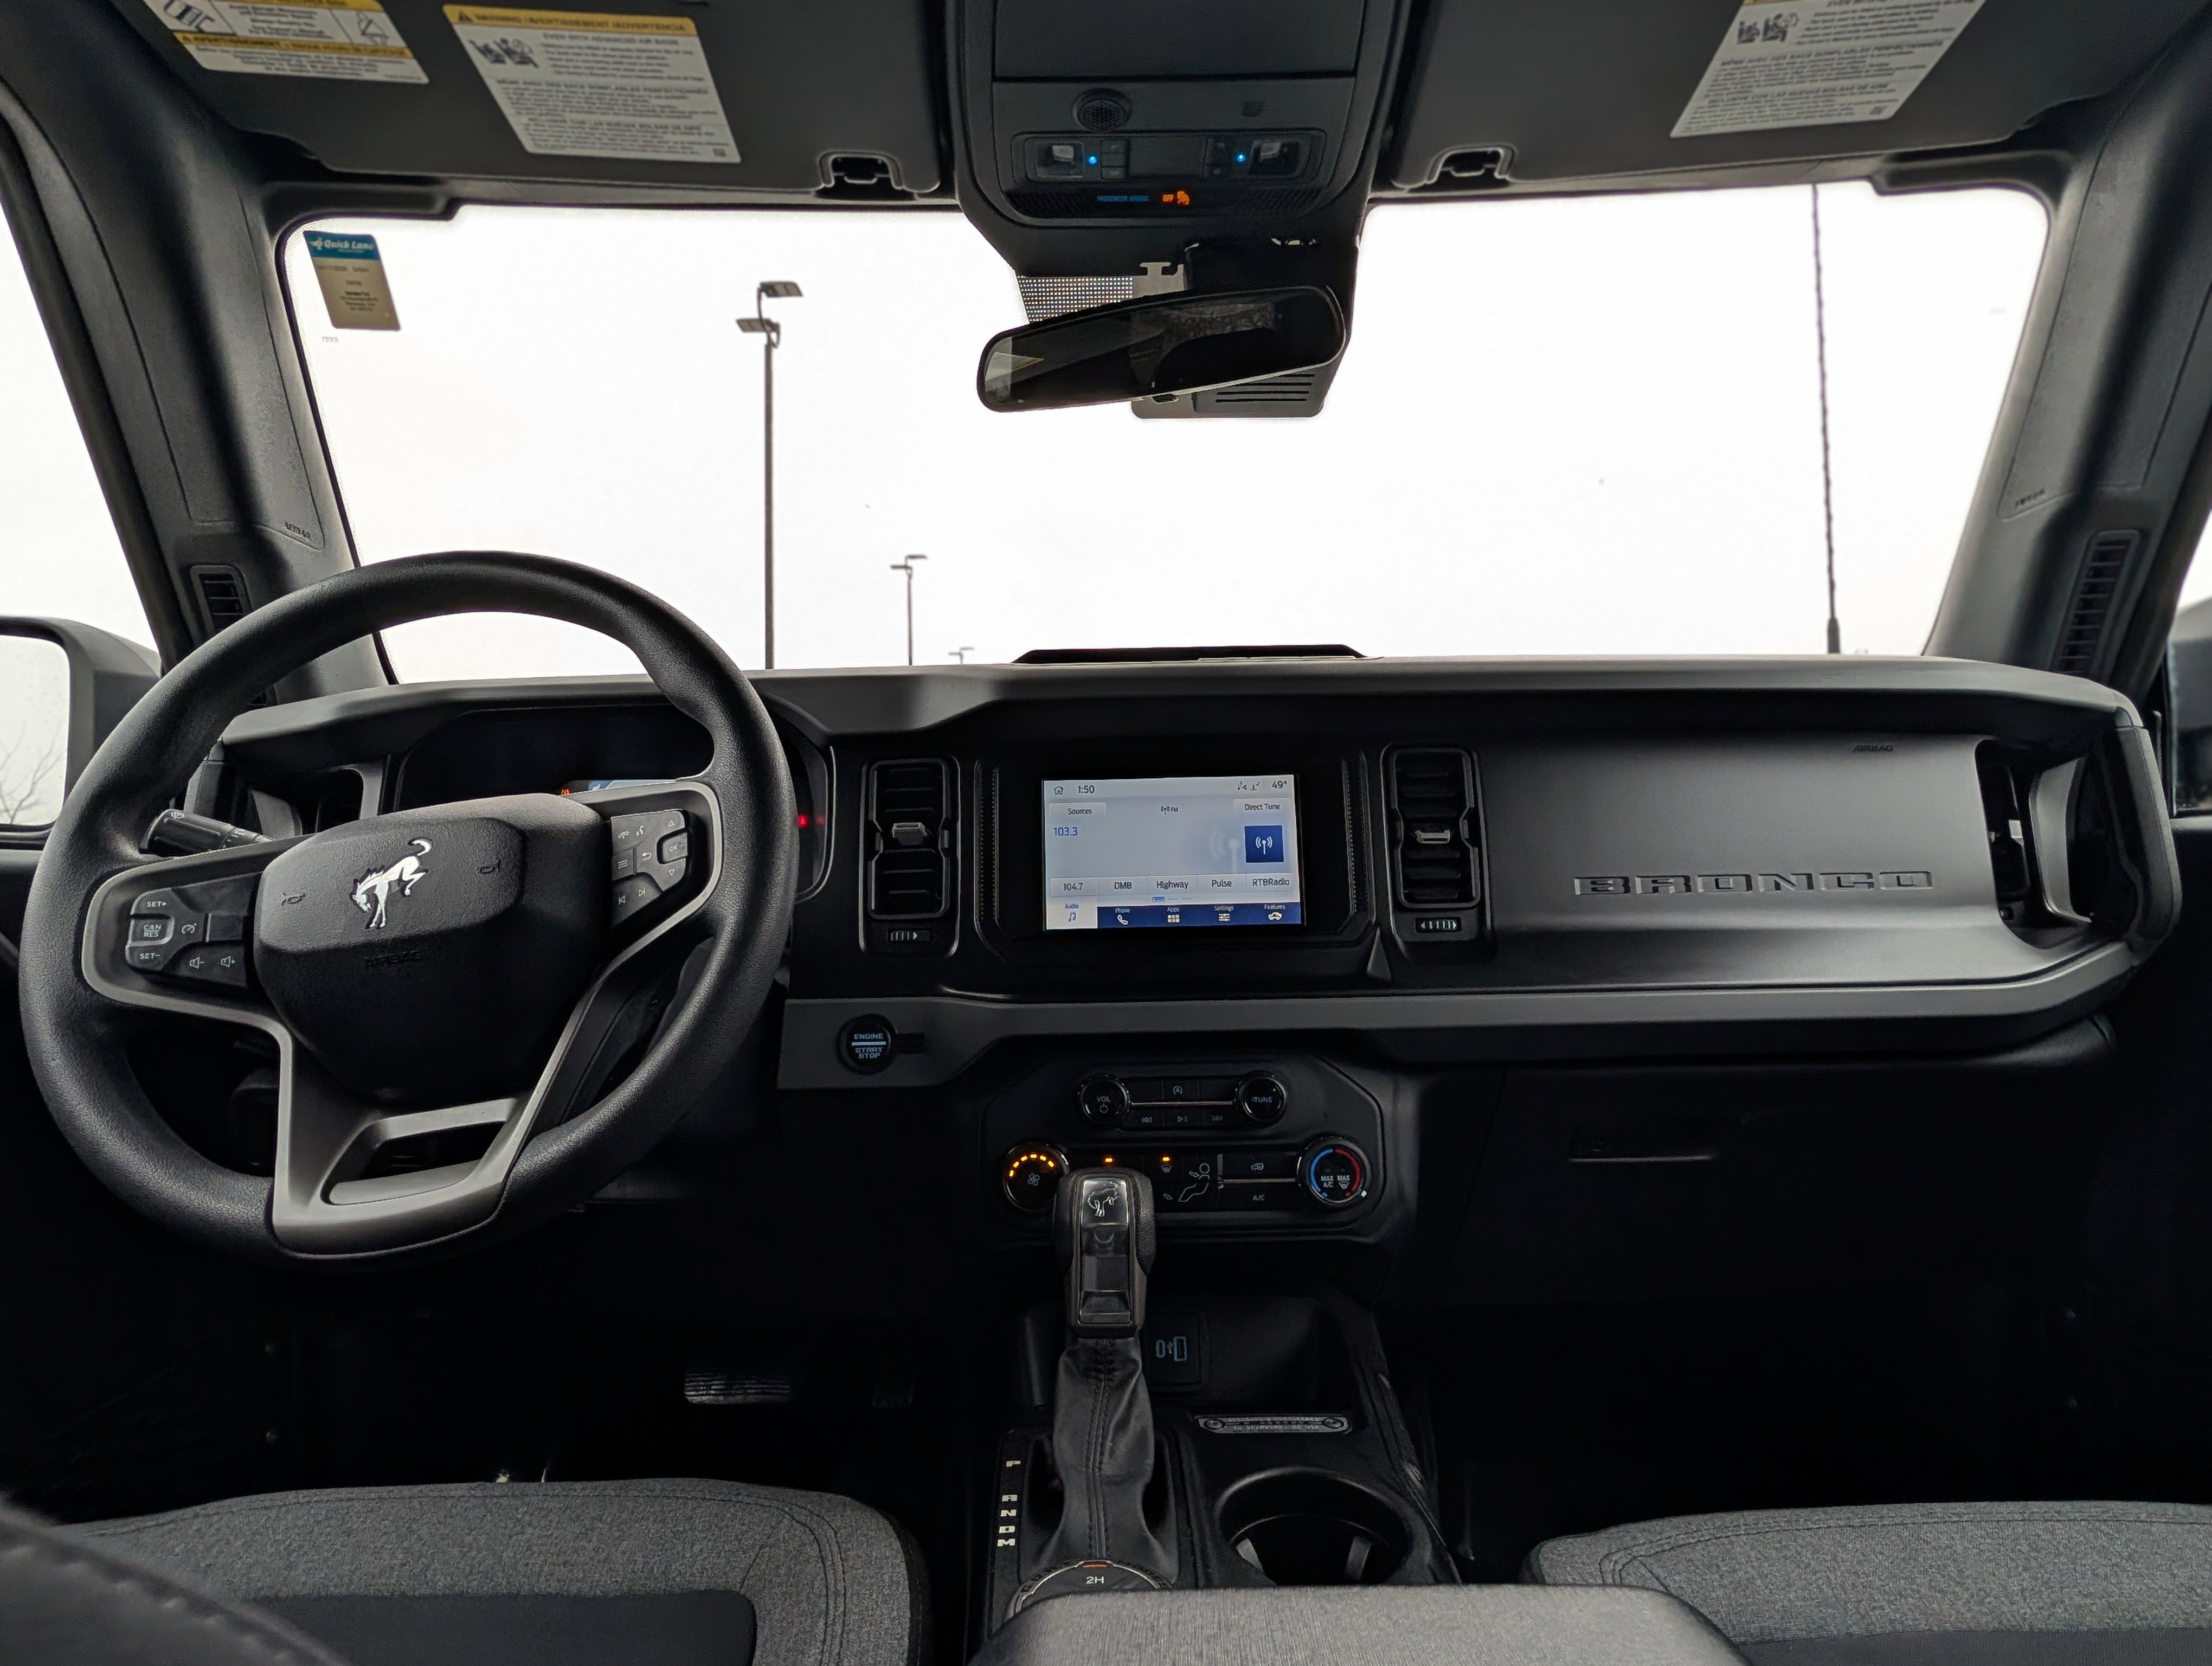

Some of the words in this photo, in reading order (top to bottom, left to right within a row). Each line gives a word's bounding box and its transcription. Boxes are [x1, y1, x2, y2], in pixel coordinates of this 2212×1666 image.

[324, 239, 350, 249] Quick
[351, 241, 374, 251] Lane
[1077, 785, 1095, 794] 1:50
[1244, 803, 1263, 811] Direct
[1053, 826, 1078, 836] 103.3
[1063, 882, 1083, 891] 104.7
[1114, 881, 1133, 890] DMB
[1156, 880, 1189, 889] Highway
[1211, 879, 1232, 888] Pulse
[1252, 877, 1290, 887] RTBRadio
[1574, 871, 1933, 895] BRONCO
[1000, 1509, 1017, 1517] N
[999, 1525, 1015, 1534] D
[996, 1538, 1016, 1547] M
[1085, 1576, 1105, 1584] 2H
